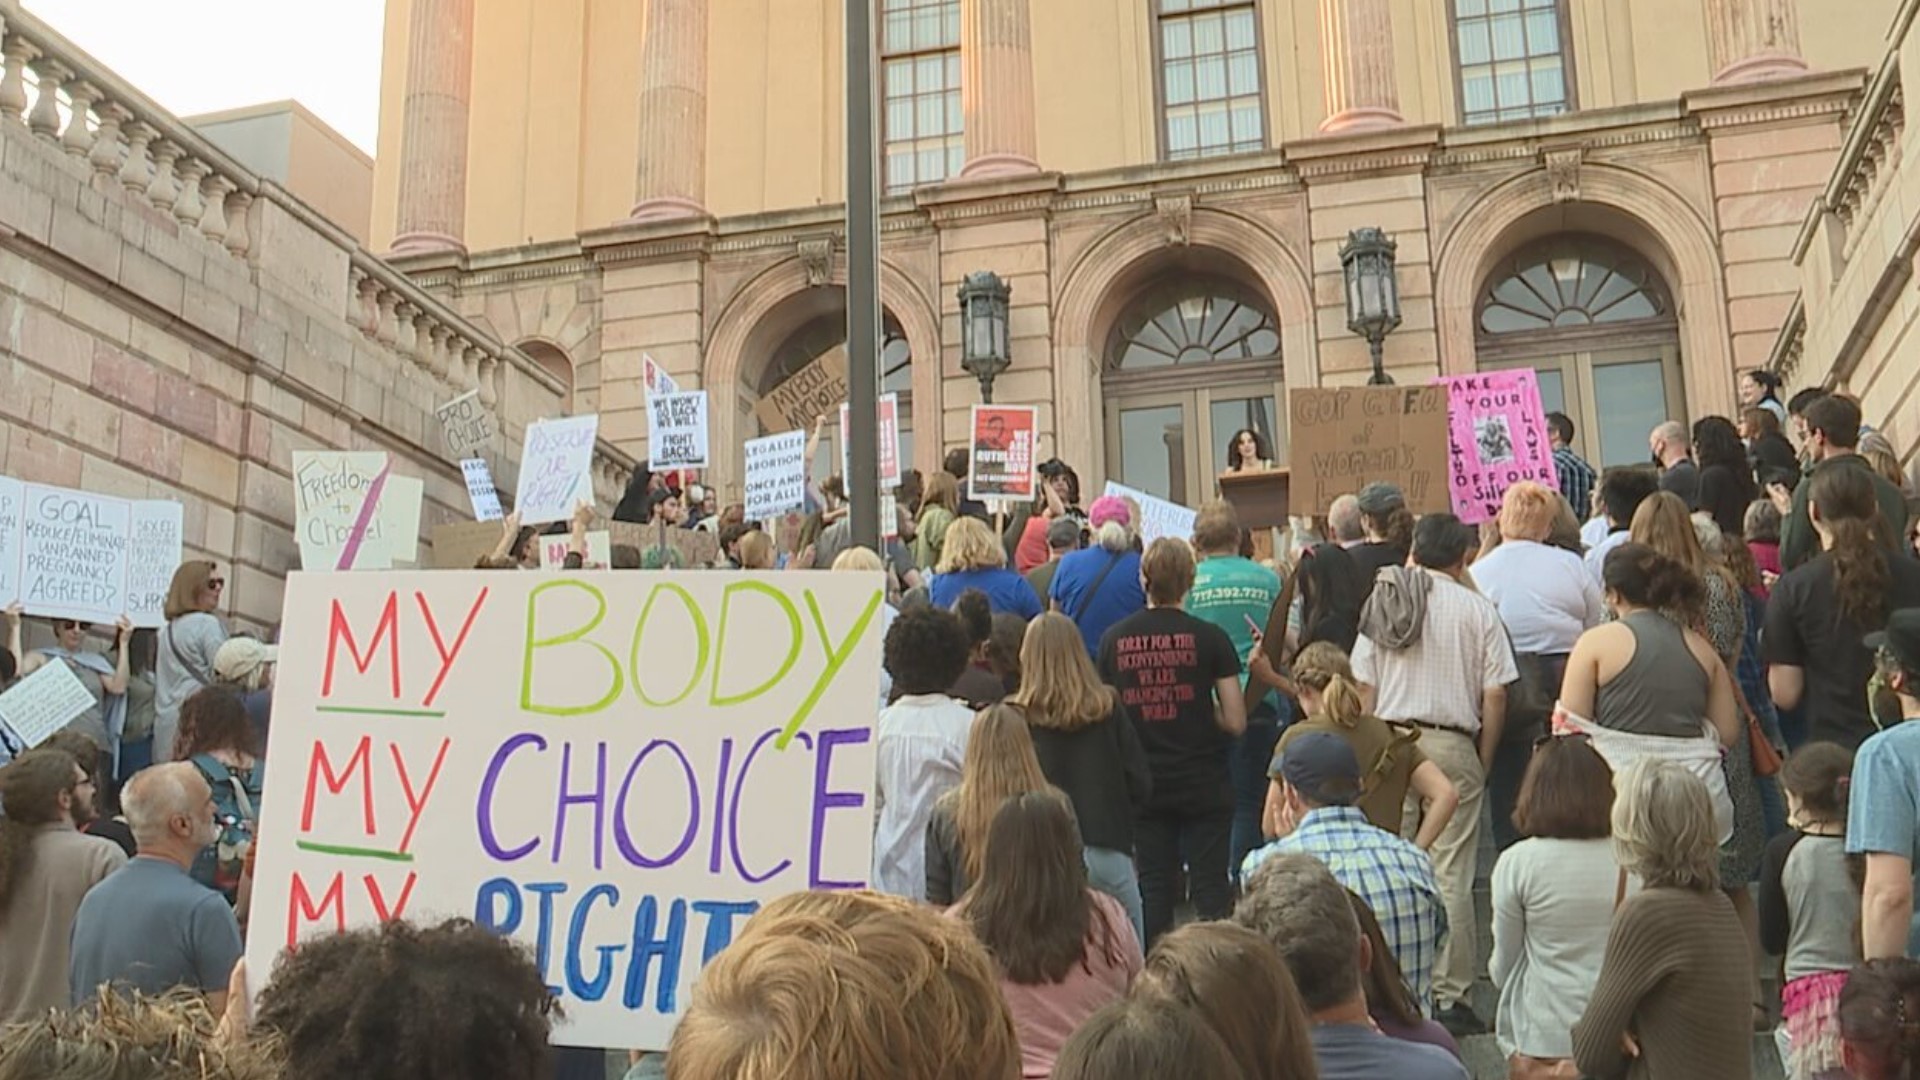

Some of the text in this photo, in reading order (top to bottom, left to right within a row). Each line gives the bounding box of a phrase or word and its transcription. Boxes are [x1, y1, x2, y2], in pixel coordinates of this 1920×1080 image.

[792, 360, 828, 395] BODY
[1451, 377, 1491, 392] AKE
[653, 398, 666, 410] WE
[1295, 391, 1350, 426] GOP
[1465, 393, 1521, 409] YOUR
[437, 399, 472, 426] PRO
[657, 405, 698, 418] GO BACK
[657, 415, 698, 429] WE WILL
[662, 433, 693, 447] FIGHT
[1013, 430, 1030, 441] WE
[662, 445, 695, 459] BACK!
[746, 438, 802, 458] LEGALIZE
[1009, 440, 1029, 451] ARE
[748, 452, 802, 472] ABORTION
[976, 449, 1029, 462] RUTHLESS
[1004, 462, 1028, 473] NOW
[746, 474, 803, 493] ONCE AND
[1455, 468, 1550, 487] OFF OUR
[748, 493, 771, 507] FOR
[39, 494, 113, 530] GOAL
[27, 554, 113, 583] PREGNANCY
[29, 573, 117, 607] AGREED?
[1117, 632, 1195, 653] SORRY FOR THE
[322, 579, 884, 751] MY BODY
[1117, 649, 1197, 671] INCONVENIENCE
[1138, 668, 1177, 686] WE ARE
[1123, 684, 1194, 705] CHANGING THE
[1141, 703, 1177, 721] WORLD
[300, 727, 871, 891] MY CHOICE
[287, 871, 417, 957] MY
